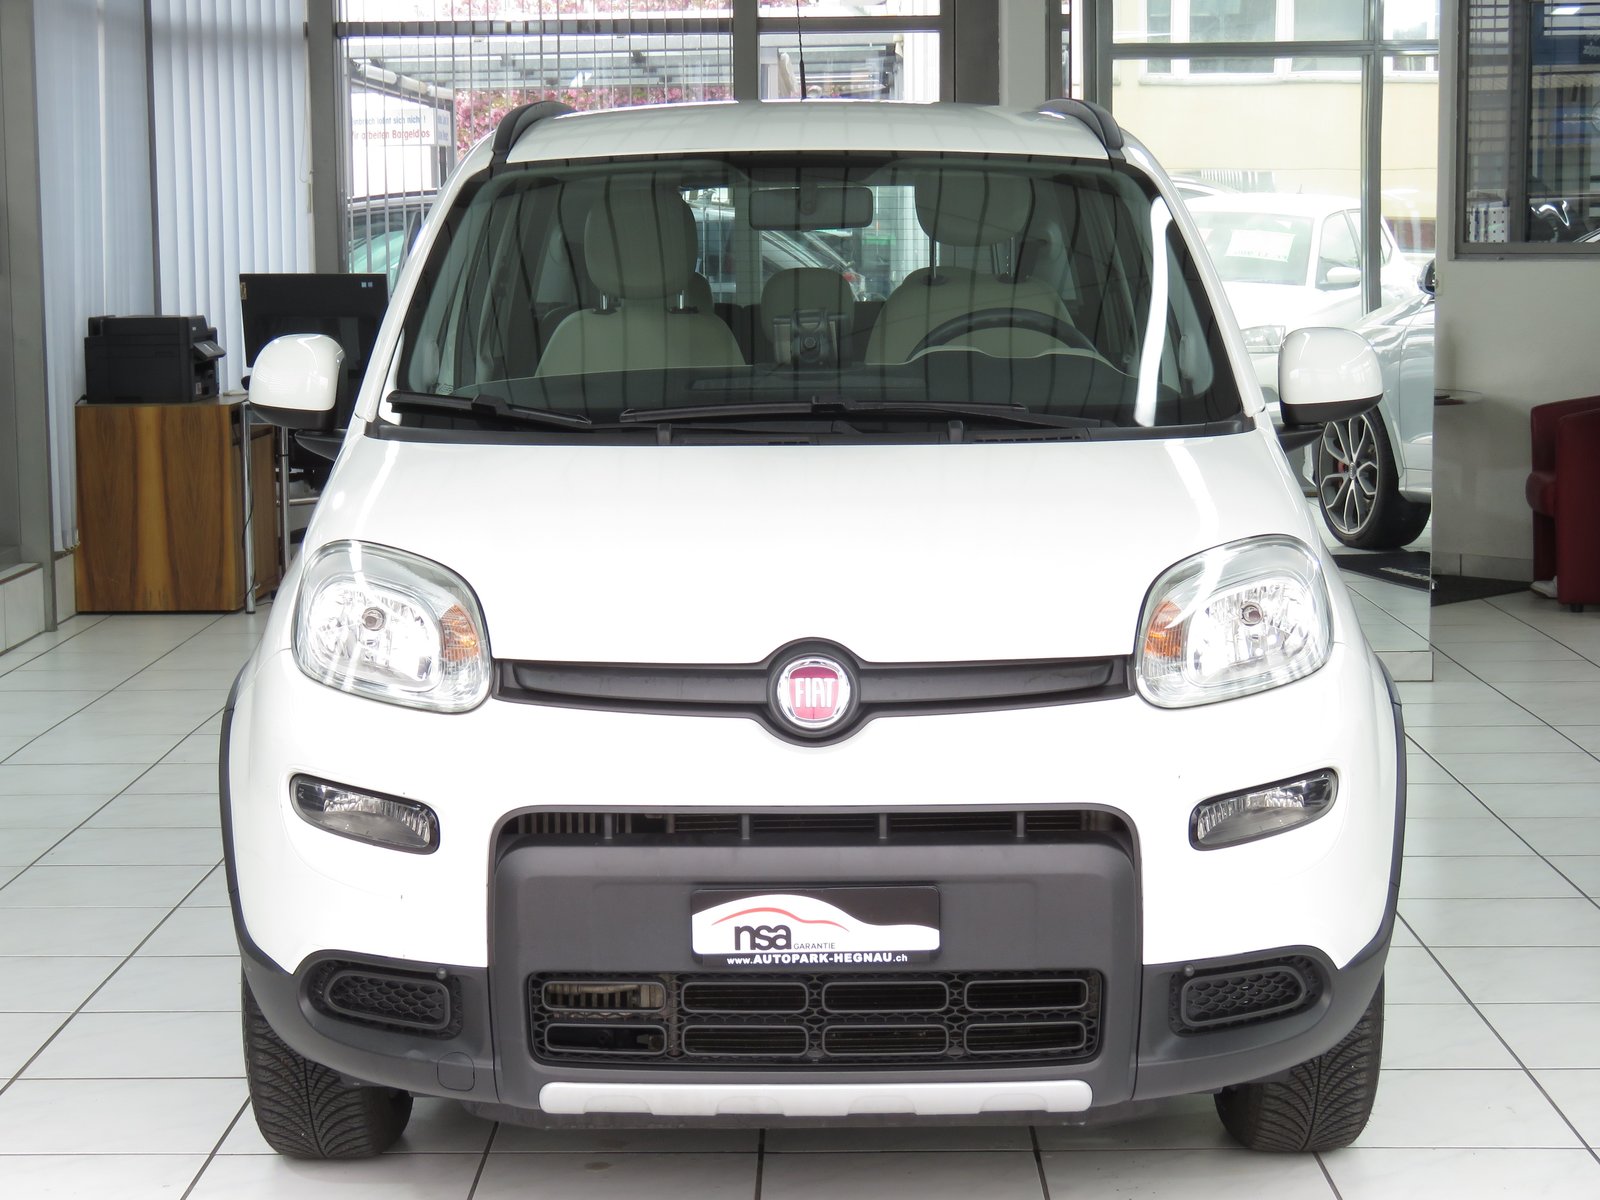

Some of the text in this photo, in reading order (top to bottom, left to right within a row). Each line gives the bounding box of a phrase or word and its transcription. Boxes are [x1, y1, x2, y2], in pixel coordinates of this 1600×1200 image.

[795, 677, 835, 708] FIAT
[734, 924, 836, 951] nsa GARANTIE
[726, 952, 908, 965] www.AUTOPARK-HEGNAU.ch
